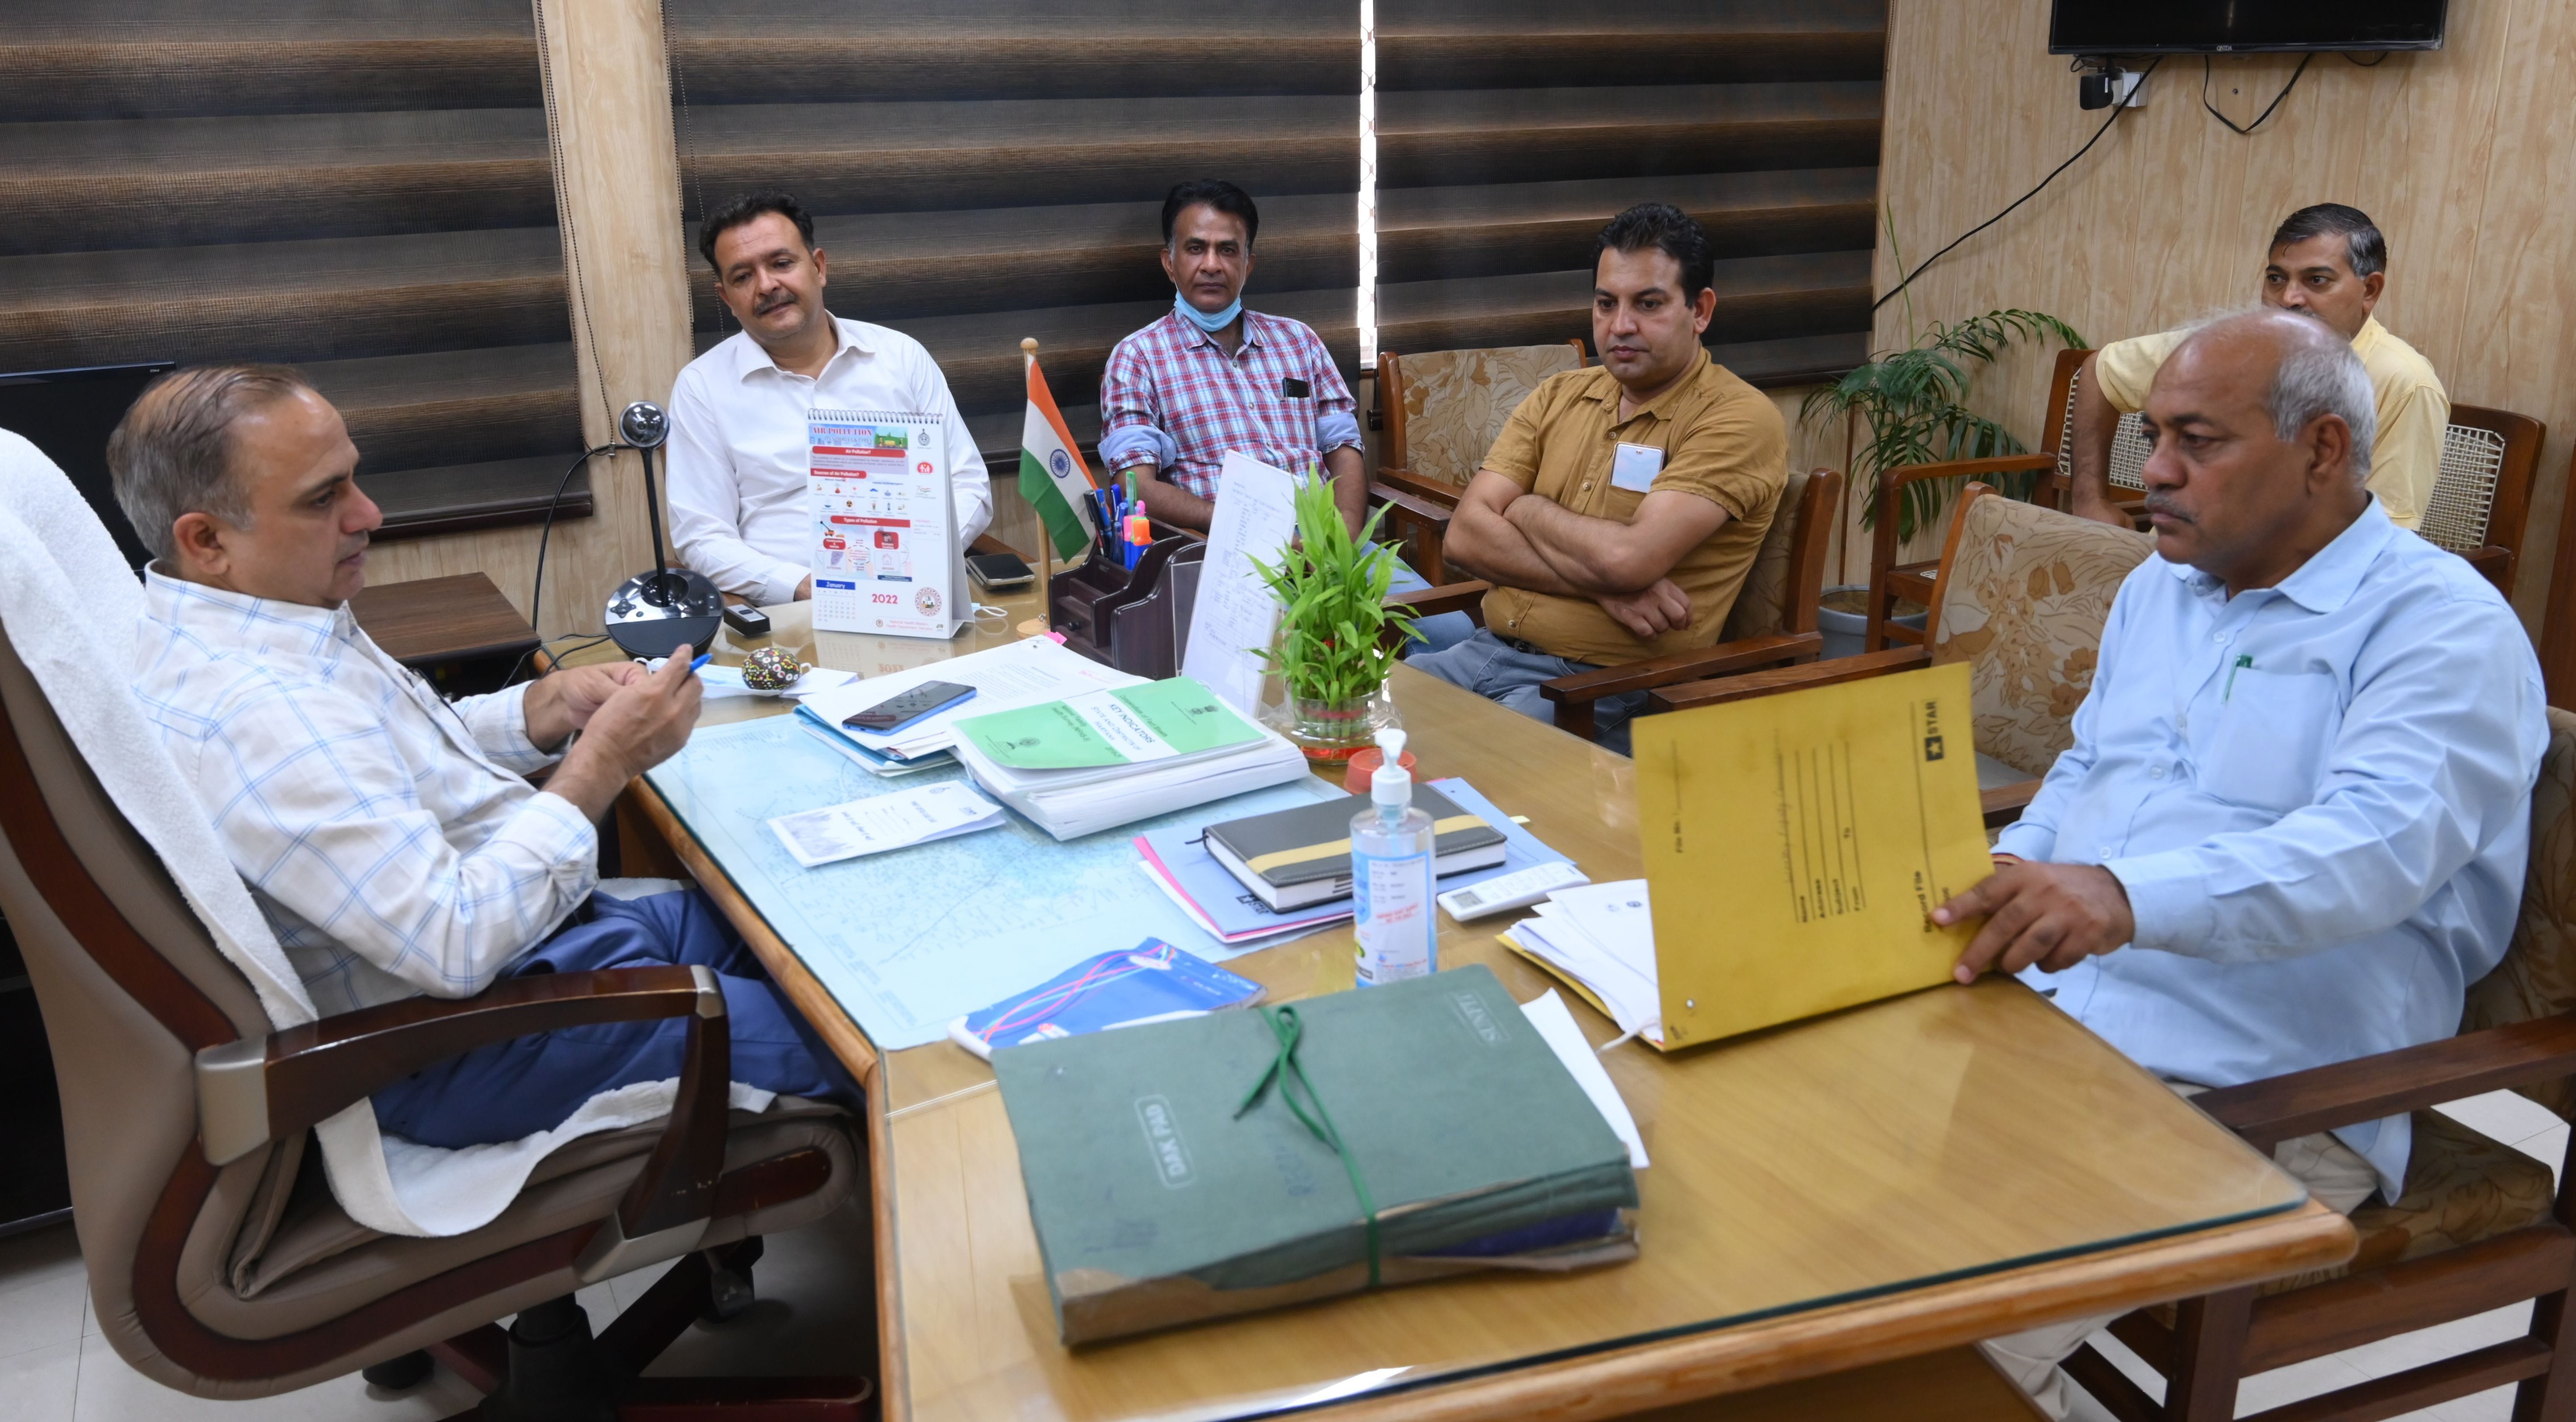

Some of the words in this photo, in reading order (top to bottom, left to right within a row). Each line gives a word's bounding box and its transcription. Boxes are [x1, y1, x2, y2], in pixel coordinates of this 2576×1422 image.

[872, 593, 898, 604] 2022
[1109, 704, 1123, 713] KEY
[1119, 713, 1155, 743] INDICATORS
[1926, 702, 1939, 735] STAR
[1675, 836, 1684, 854] File
[1816, 878, 1826, 918] Address
[1832, 878, 1844, 915] Subject
[1914, 870, 1924, 891] File
[1852, 886, 1861, 911] From
[1918, 894, 1933, 933] Record
[1145, 1103, 1172, 1138] PAD
[1158, 1137, 1187, 1178] DAK
